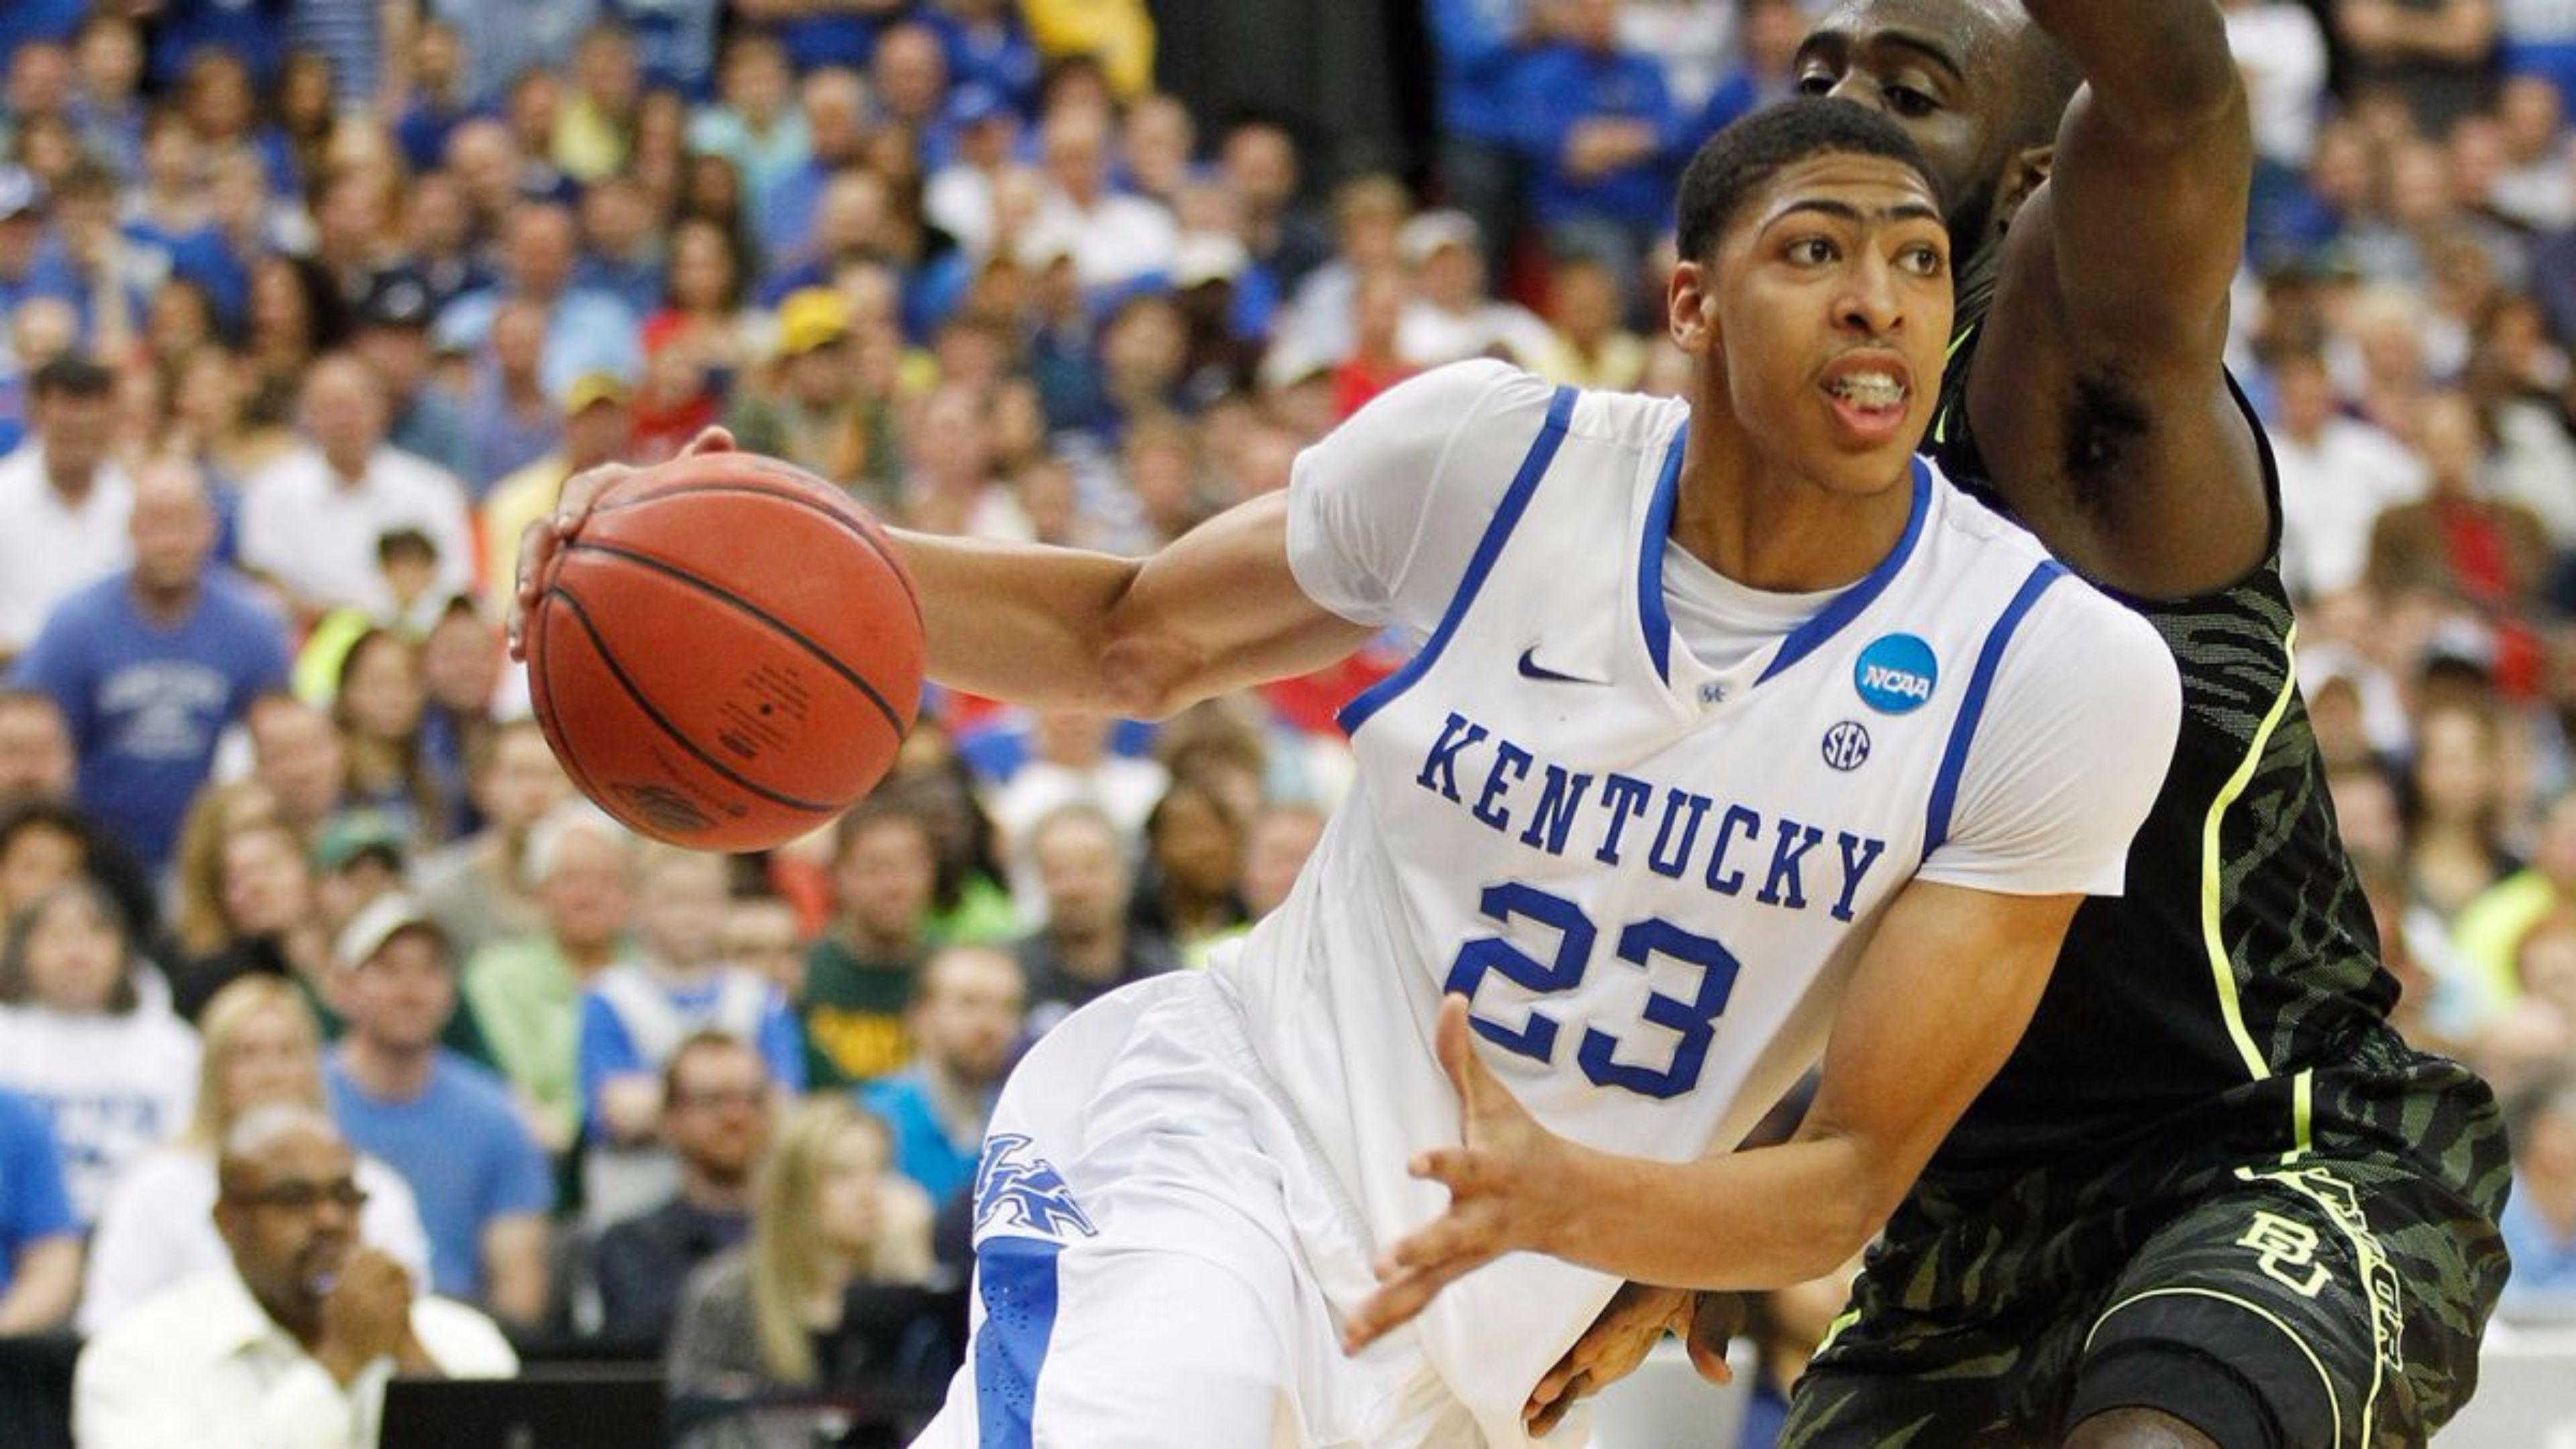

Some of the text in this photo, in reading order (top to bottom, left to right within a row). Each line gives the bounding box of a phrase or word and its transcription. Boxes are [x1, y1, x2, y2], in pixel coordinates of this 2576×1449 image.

[1863, 665, 1931, 701] NCAA
[1824, 722, 1869, 770] SEC
[1416, 712, 1885, 923] KENTUCKY
[1444, 881, 1741, 1100] 23
[2235, 1210, 2333, 1298] BU
